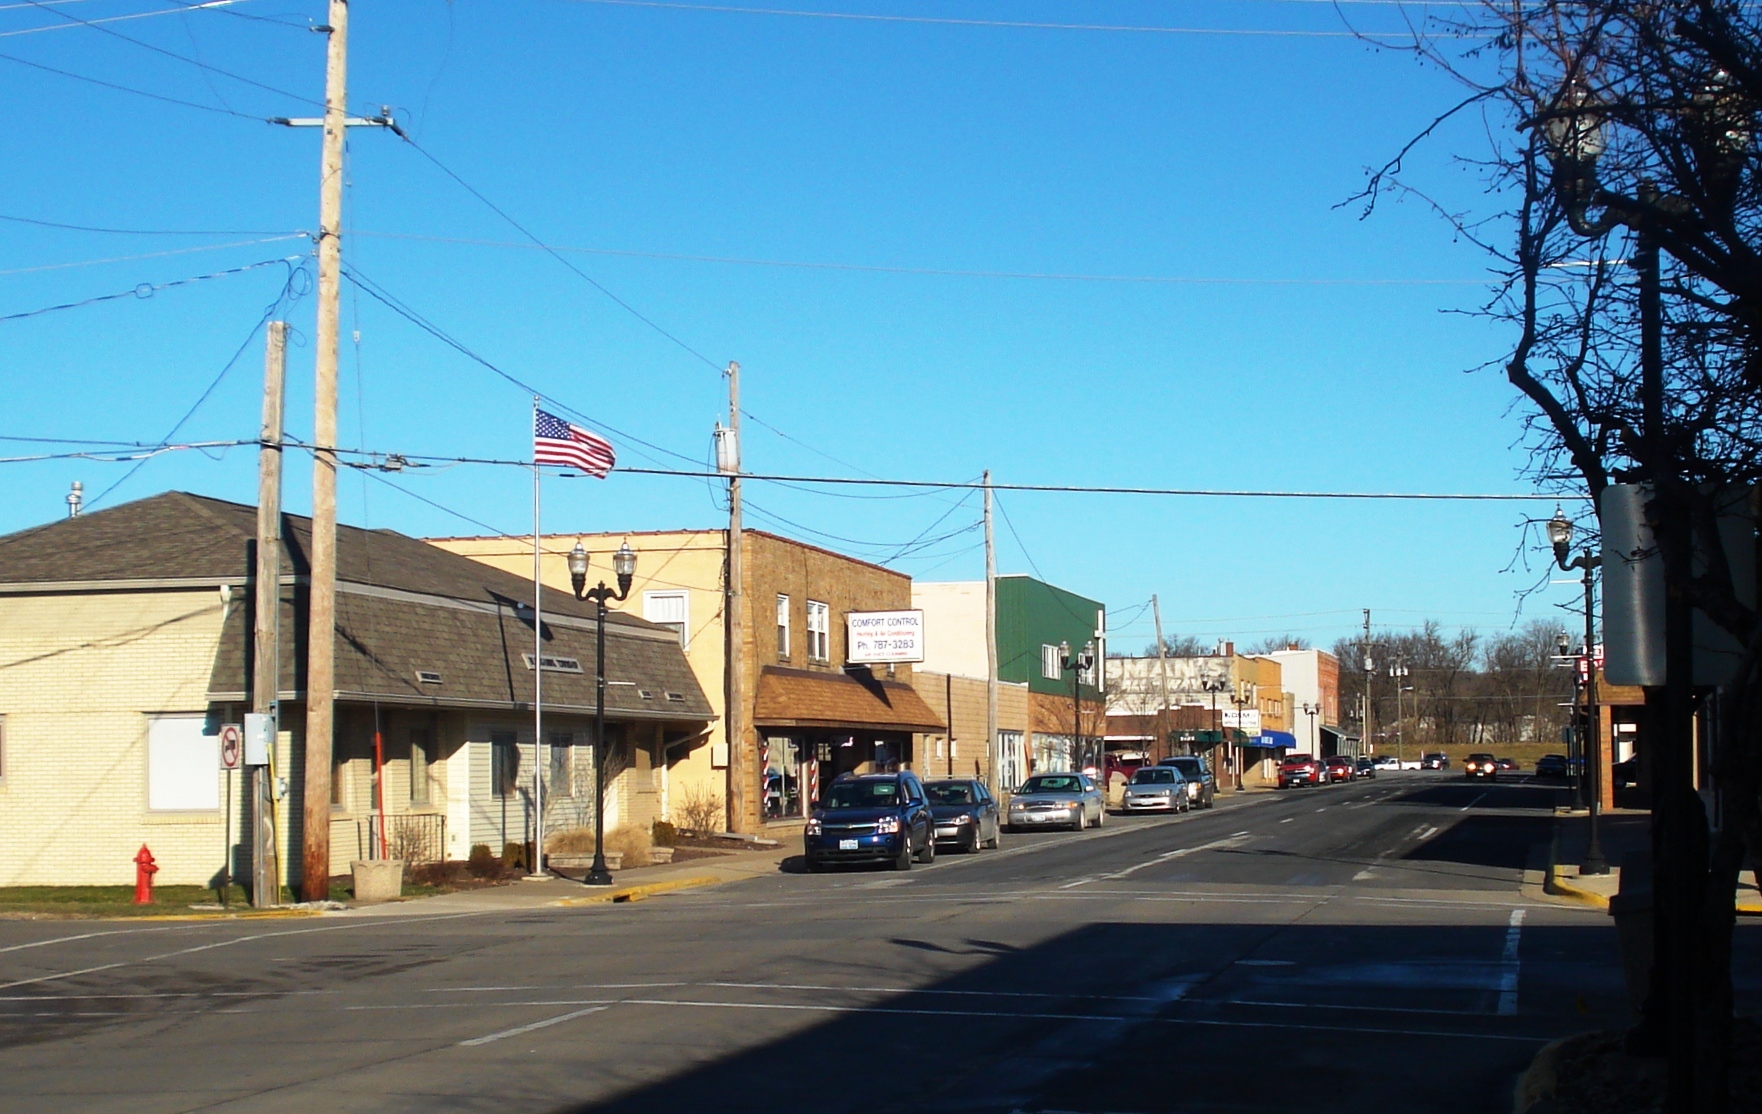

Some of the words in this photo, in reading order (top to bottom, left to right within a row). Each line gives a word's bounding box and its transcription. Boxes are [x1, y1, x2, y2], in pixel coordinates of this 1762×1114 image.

[852, 618, 884, 627] COMFORT
[887, 617, 918, 626] CONTROL
[858, 641, 869, 650] Ph.
[873, 639, 914, 650] 787-3283
